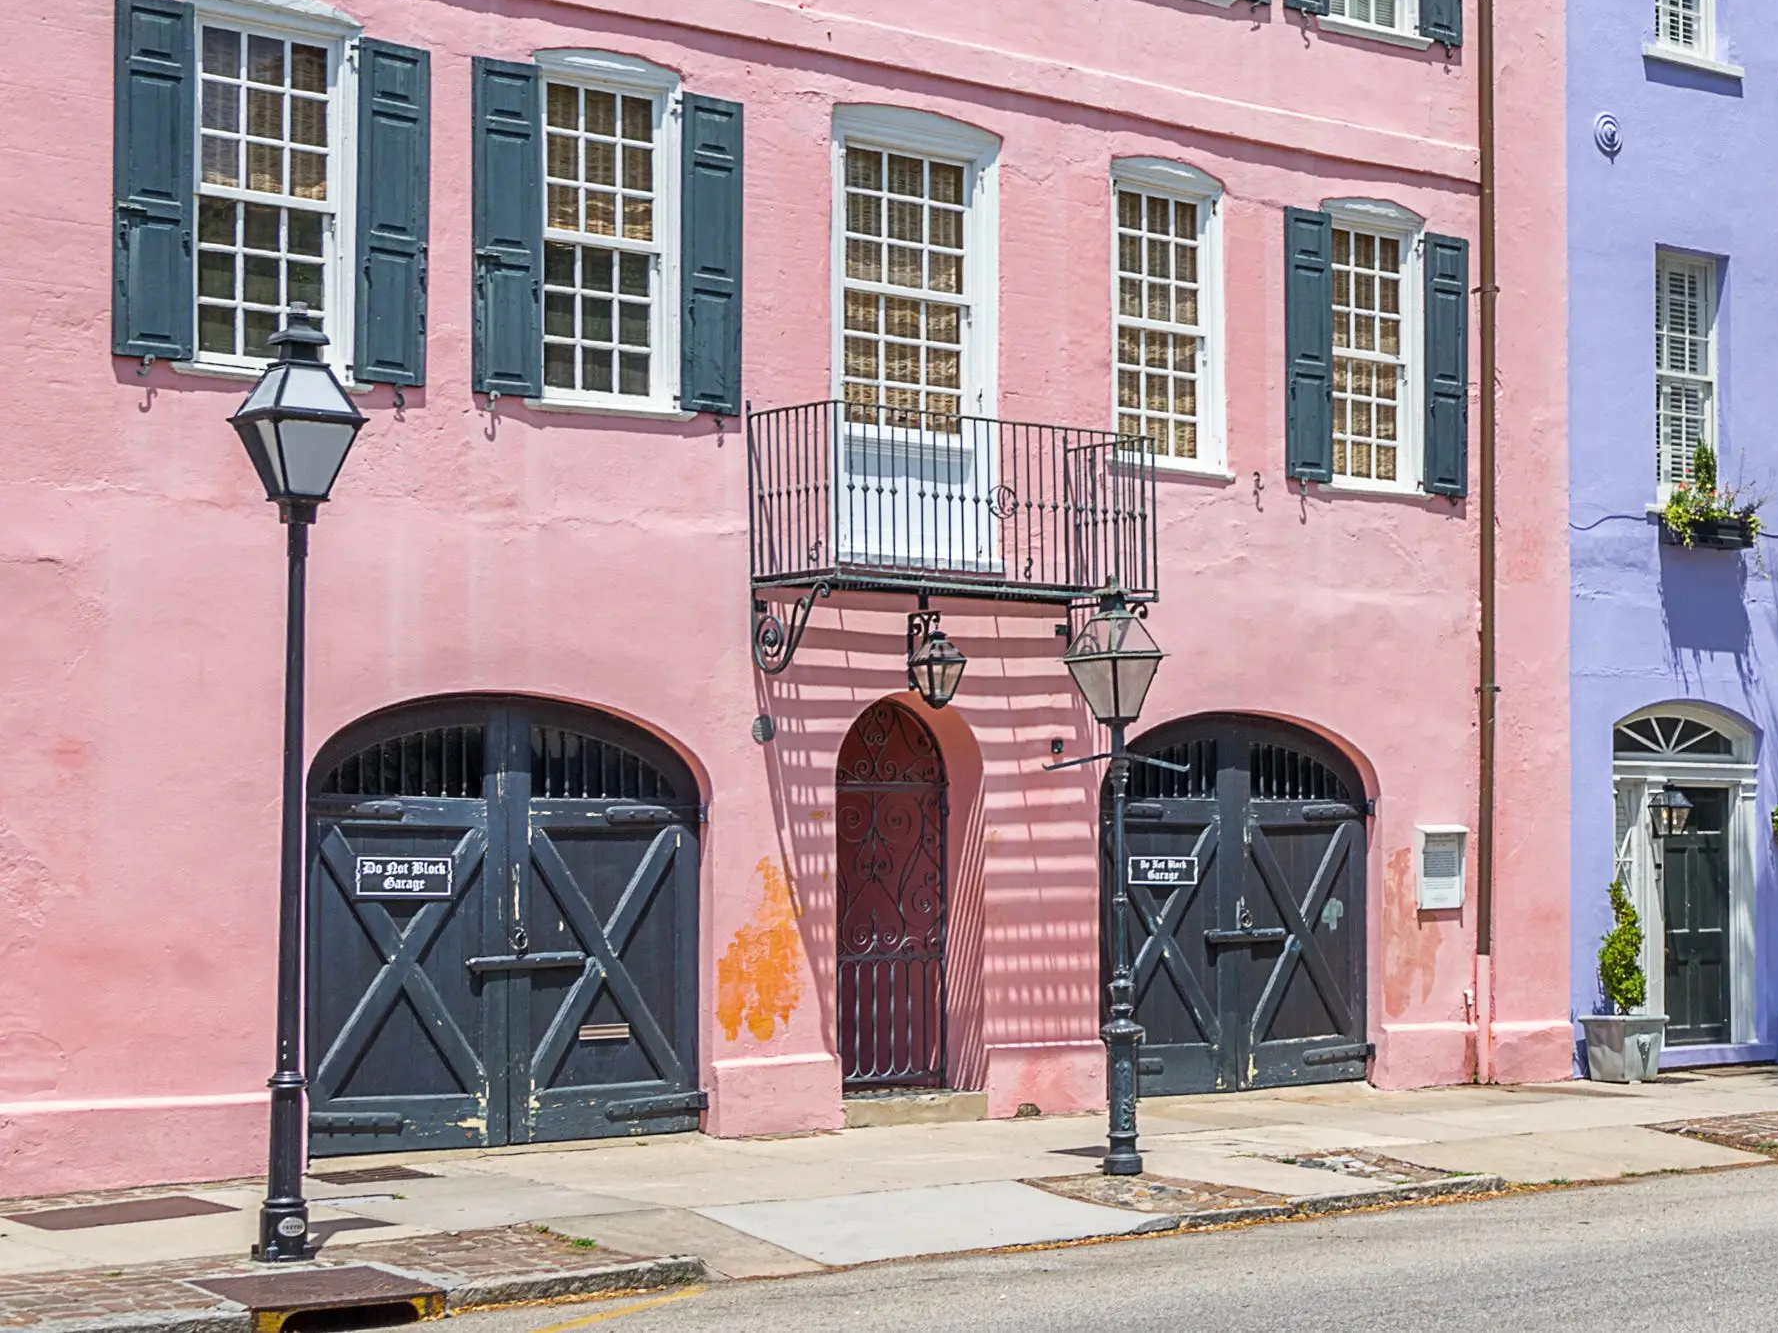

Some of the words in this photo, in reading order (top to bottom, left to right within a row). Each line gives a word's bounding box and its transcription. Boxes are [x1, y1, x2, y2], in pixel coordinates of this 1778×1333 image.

[362, 862, 382, 875] Do
[384, 862, 408, 876] Not
[411, 862, 446, 876] Block
[1147, 869, 1179, 882] Garage
[383, 876, 426, 891] Garage
